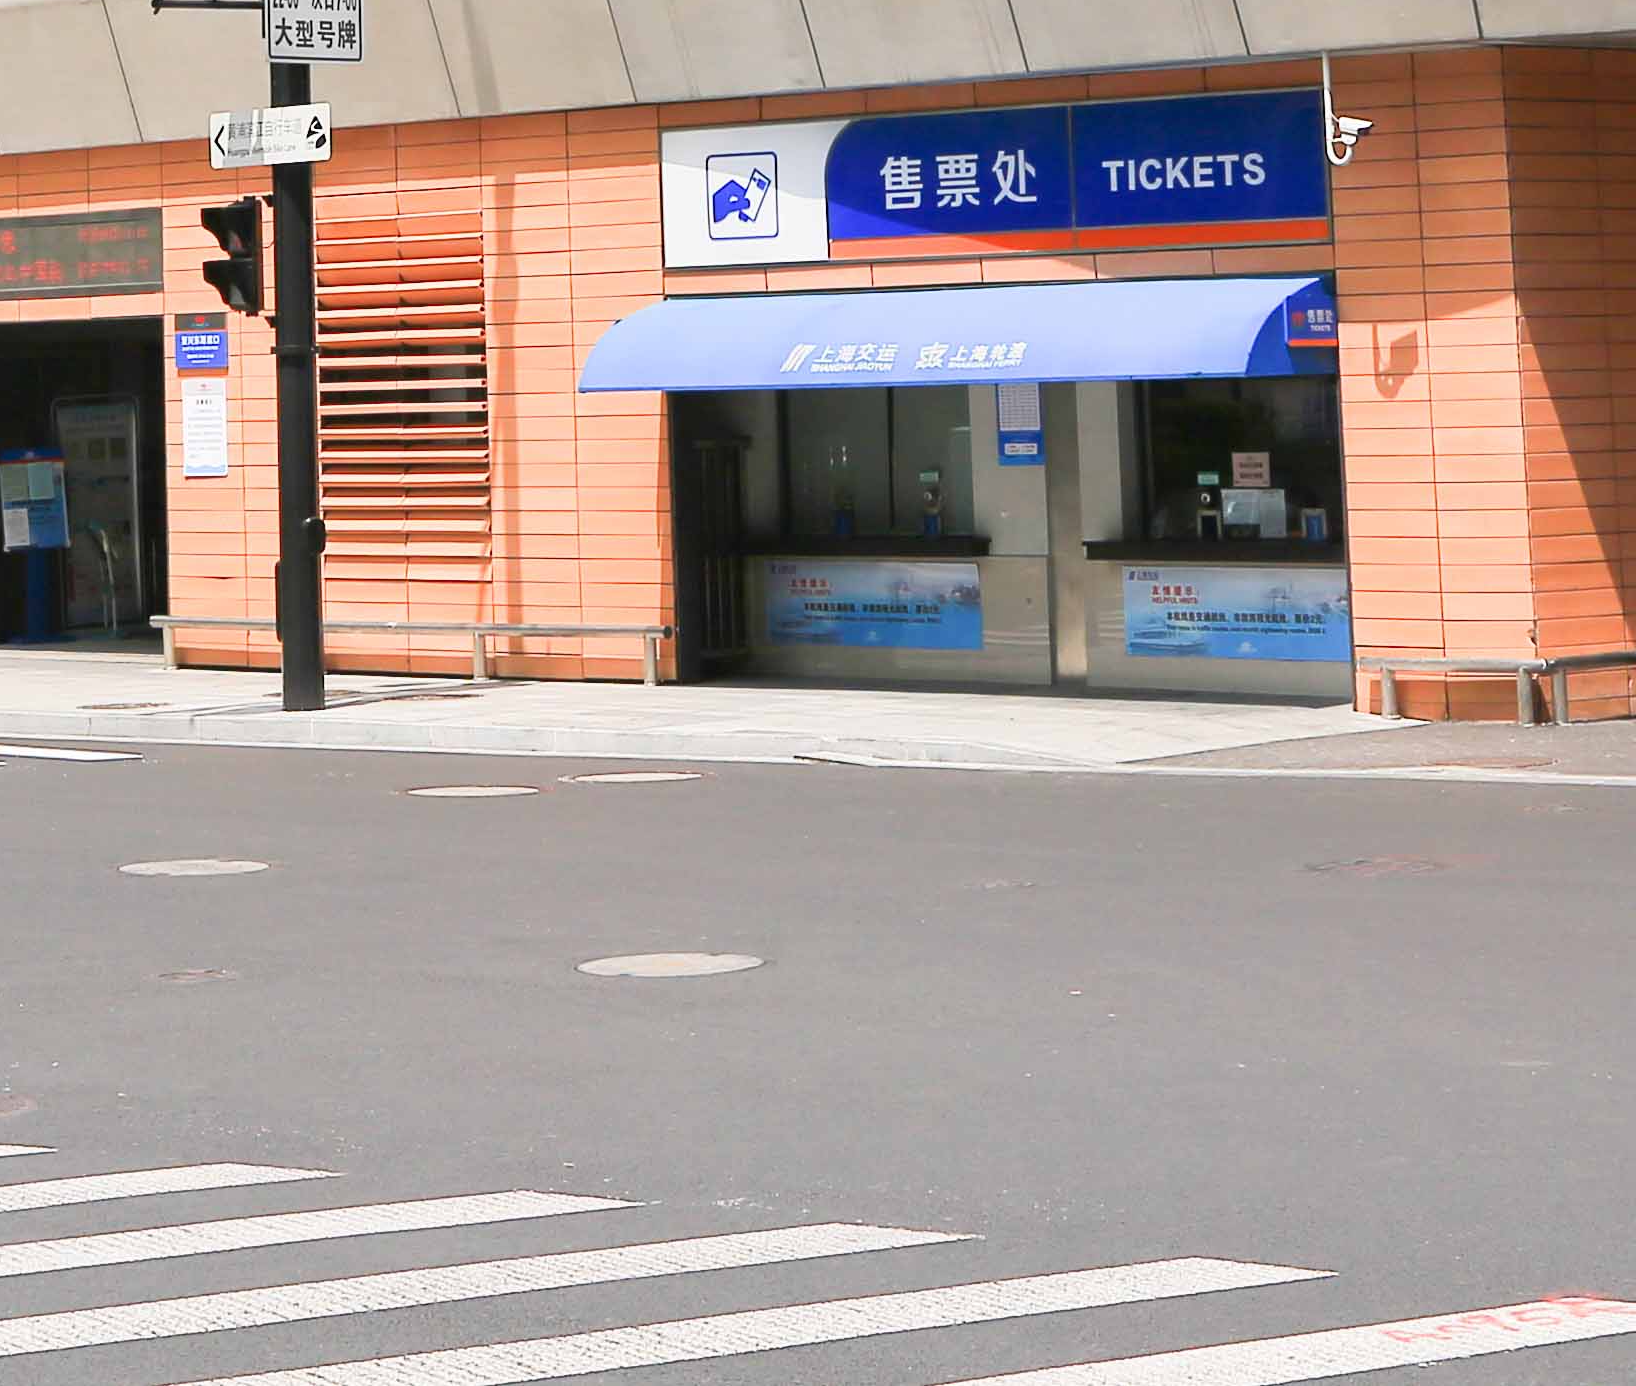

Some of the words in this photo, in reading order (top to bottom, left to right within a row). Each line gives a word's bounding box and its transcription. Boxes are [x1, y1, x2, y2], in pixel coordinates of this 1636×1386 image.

[275, 17, 357, 50] 大型号牌
[880, 149, 1037, 211] 售票处
[1101, 152, 1266, 192] TICKETS
